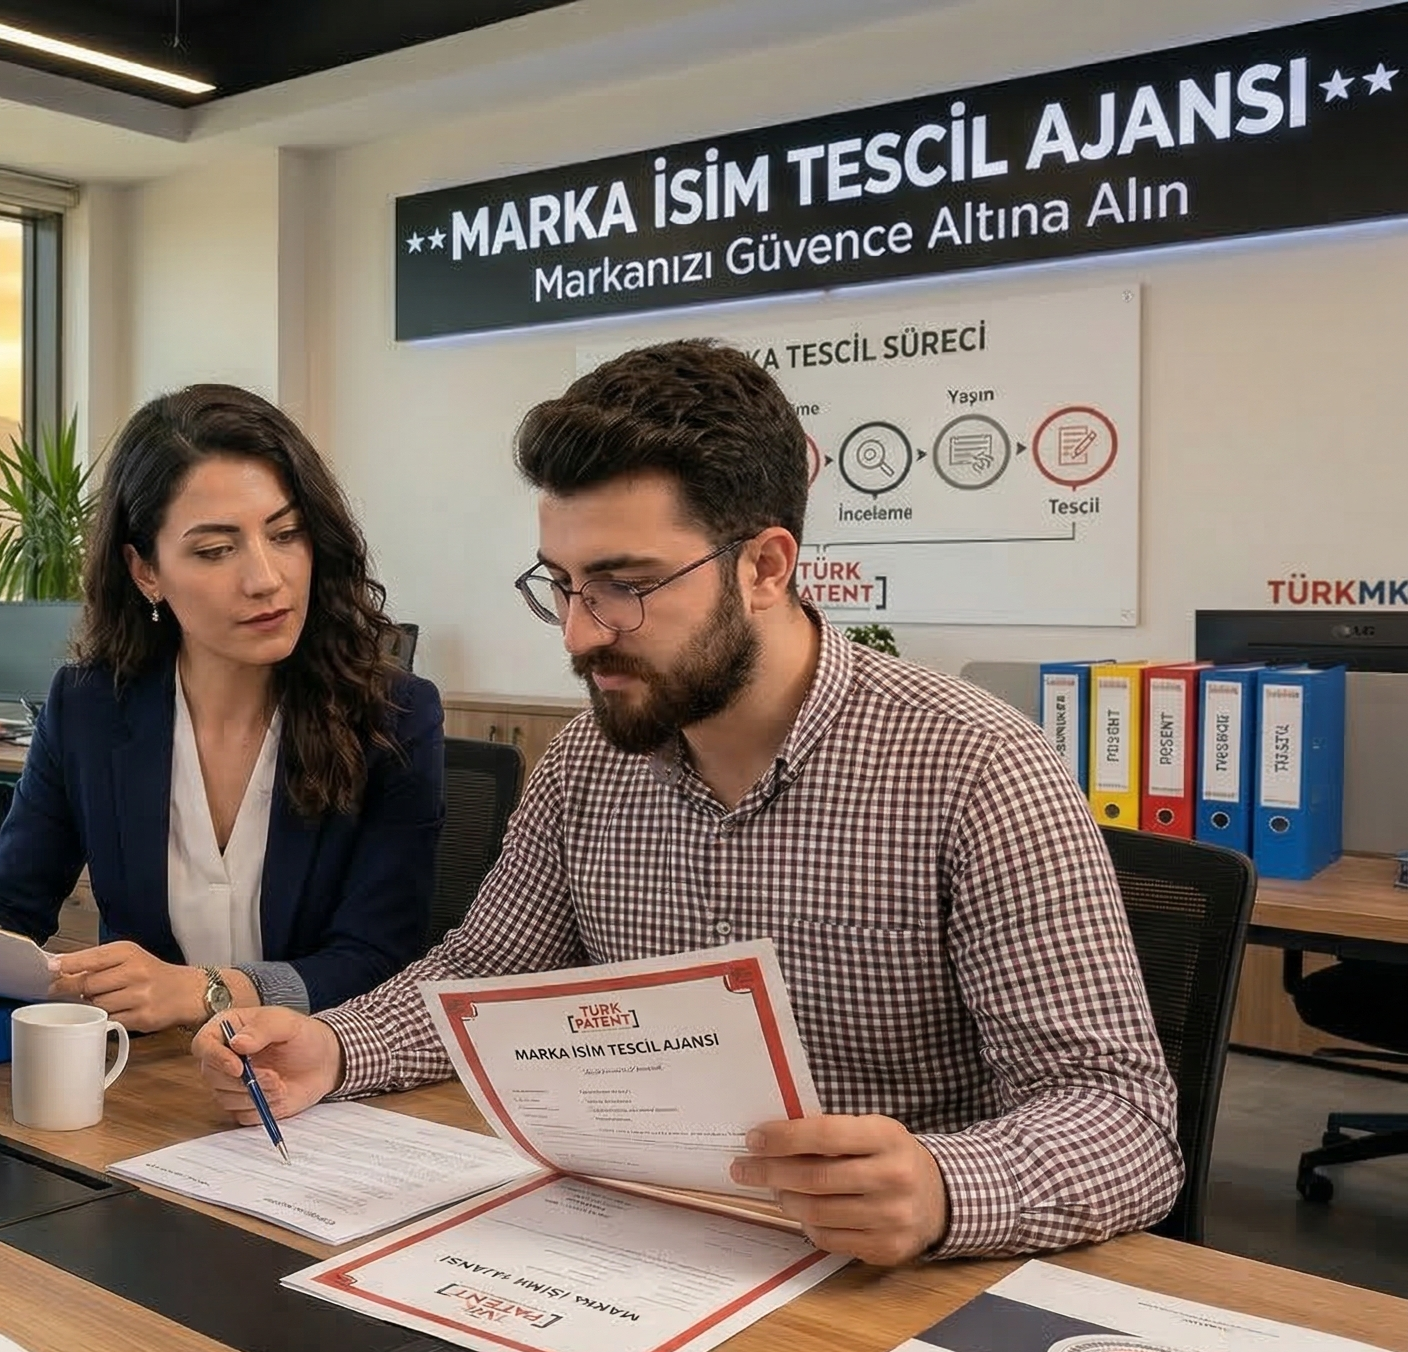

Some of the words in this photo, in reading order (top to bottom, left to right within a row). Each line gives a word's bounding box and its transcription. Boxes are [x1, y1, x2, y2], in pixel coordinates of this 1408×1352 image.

[452, 180, 638, 261] MARKA
[654, 147, 770, 229] İSİM
[787, 101, 1009, 206] TESCİL
[1025, 57, 1308, 170] AJANSI
[535, 250, 713, 303] Markanızı
[726, 217, 913, 275] Güvence
[927, 199, 1070, 250] Altına
[1086, 176, 1189, 228] Alın
[786, 332, 877, 369] TESCİL
[883, 319, 986, 360] SÜRECİ
[1049, 497, 1100, 515] Tescil
[798, 556, 861, 581] TÜRK
[514, 1047, 570, 1061] MARKA
[607, 1038, 662, 1057] TESCİL
[663, 1032, 720, 1052] AJANSI
